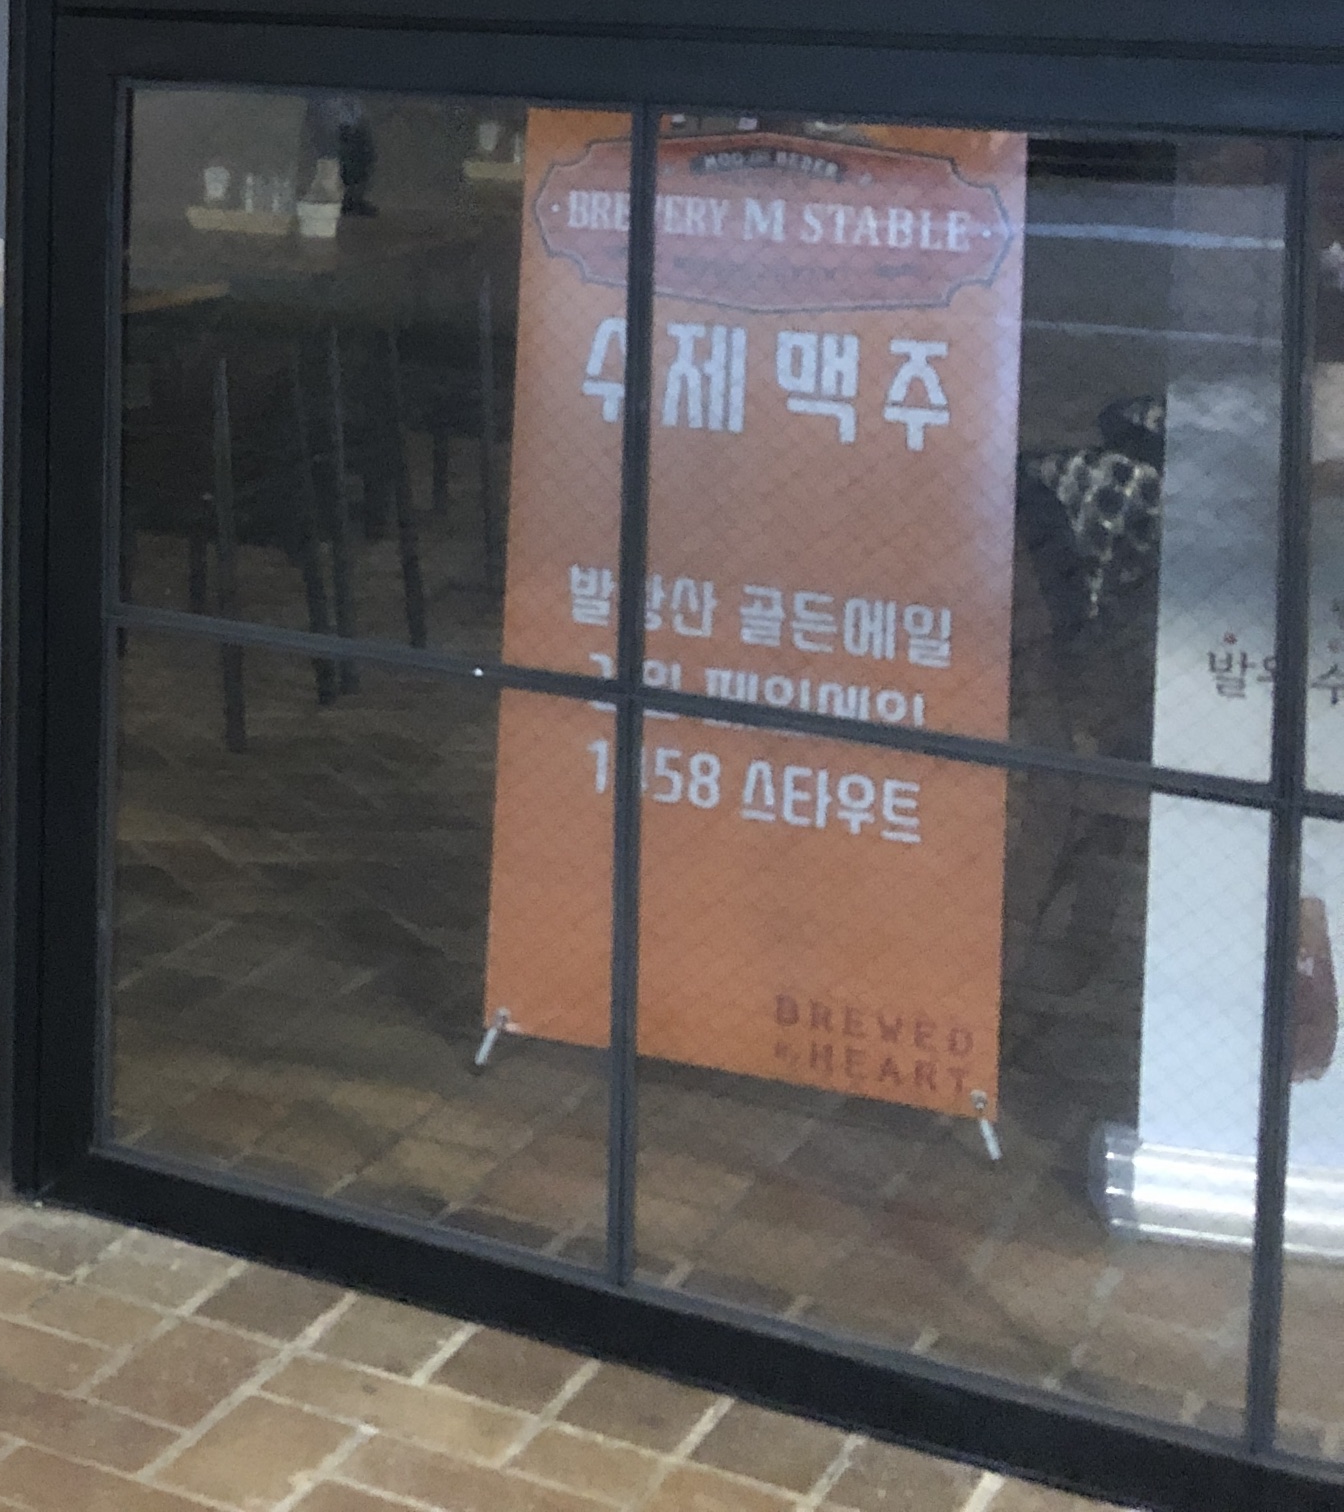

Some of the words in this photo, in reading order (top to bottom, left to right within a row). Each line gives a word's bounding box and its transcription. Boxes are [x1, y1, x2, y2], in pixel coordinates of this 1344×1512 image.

[568, 190, 729, 236] BREERY
[744, 198, 786, 241] M
[801, 203, 971, 252] STABLE
[588, 738, 720, 808] 158
[741, 760, 921, 844] 스타우트
[776, 994, 974, 1057] BREWED
[810, 1042, 970, 1093] HEART
